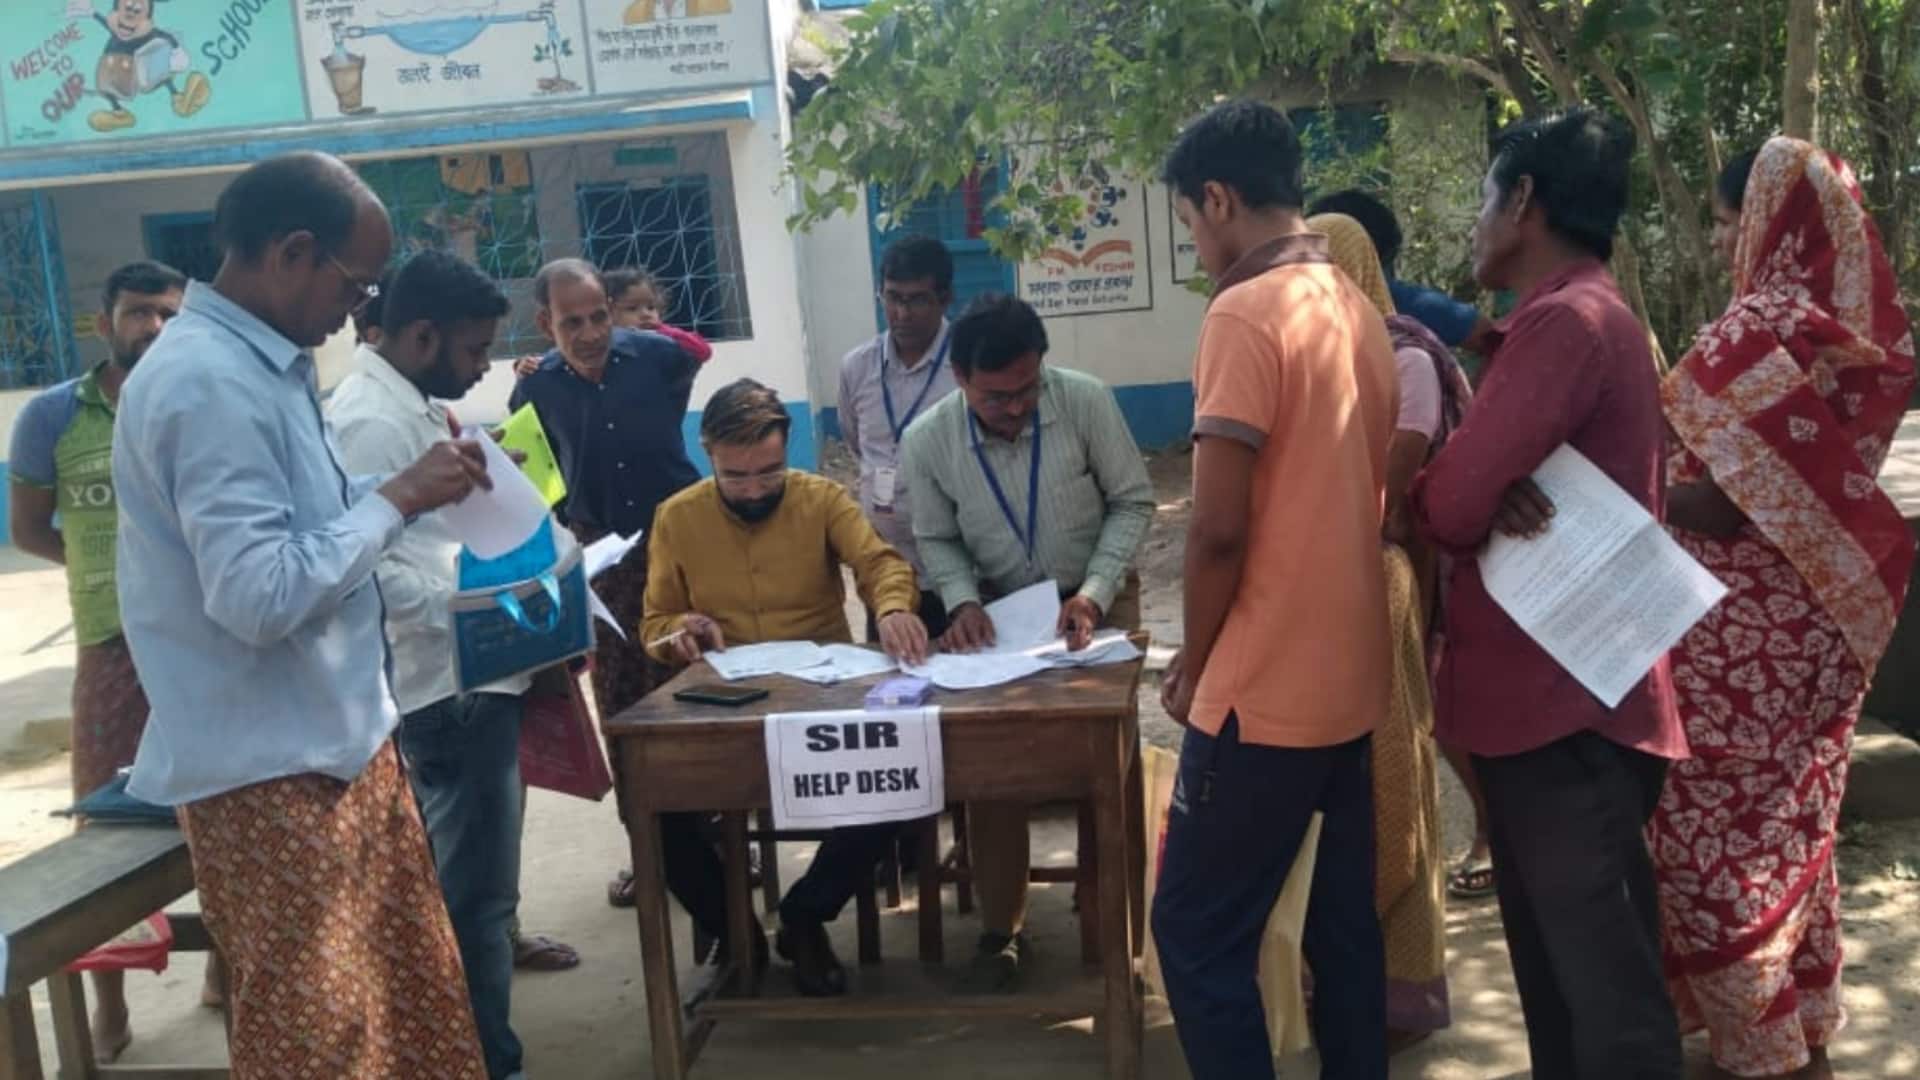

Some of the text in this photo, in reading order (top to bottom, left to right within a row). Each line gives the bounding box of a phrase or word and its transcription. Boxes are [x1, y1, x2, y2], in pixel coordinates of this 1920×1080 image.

[10, 22, 85, 81] WELCOME
[51, 55, 73, 76] TO
[42, 72, 85, 122] OUR
[806, 721, 899, 752] SIR
[793, 767, 920, 799] HELP DESK
